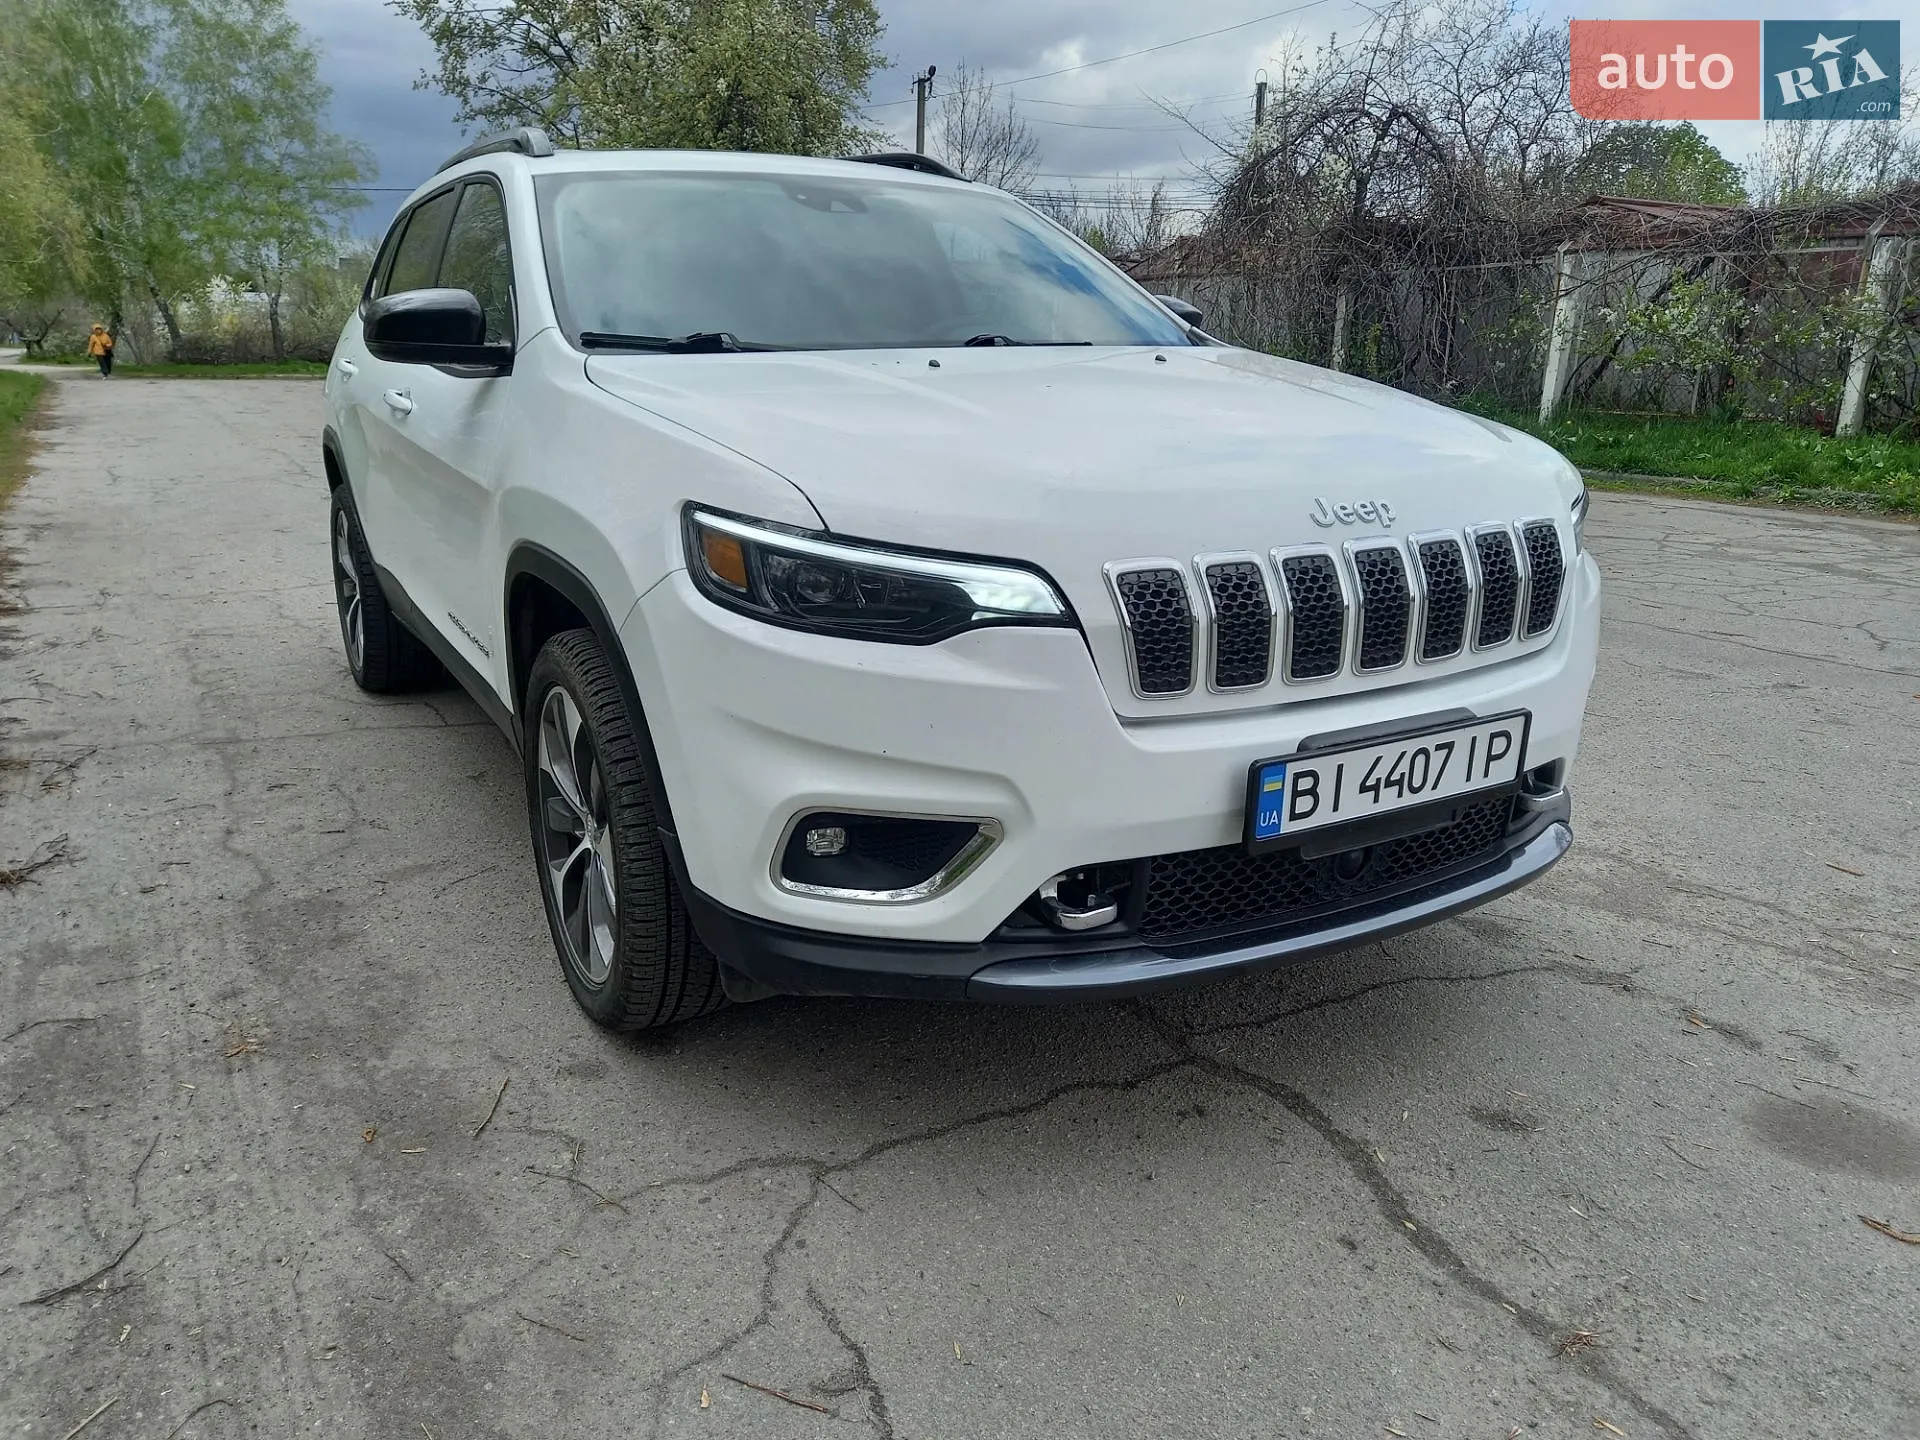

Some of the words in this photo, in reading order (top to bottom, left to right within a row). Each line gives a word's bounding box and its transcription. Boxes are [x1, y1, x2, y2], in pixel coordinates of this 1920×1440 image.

[1309, 497, 1396, 528] Jeep
[1288, 763, 1344, 822] BI
[1358, 740, 1455, 804] 4407
[1465, 729, 1513, 783] IP
[1259, 810, 1279, 827] UA
